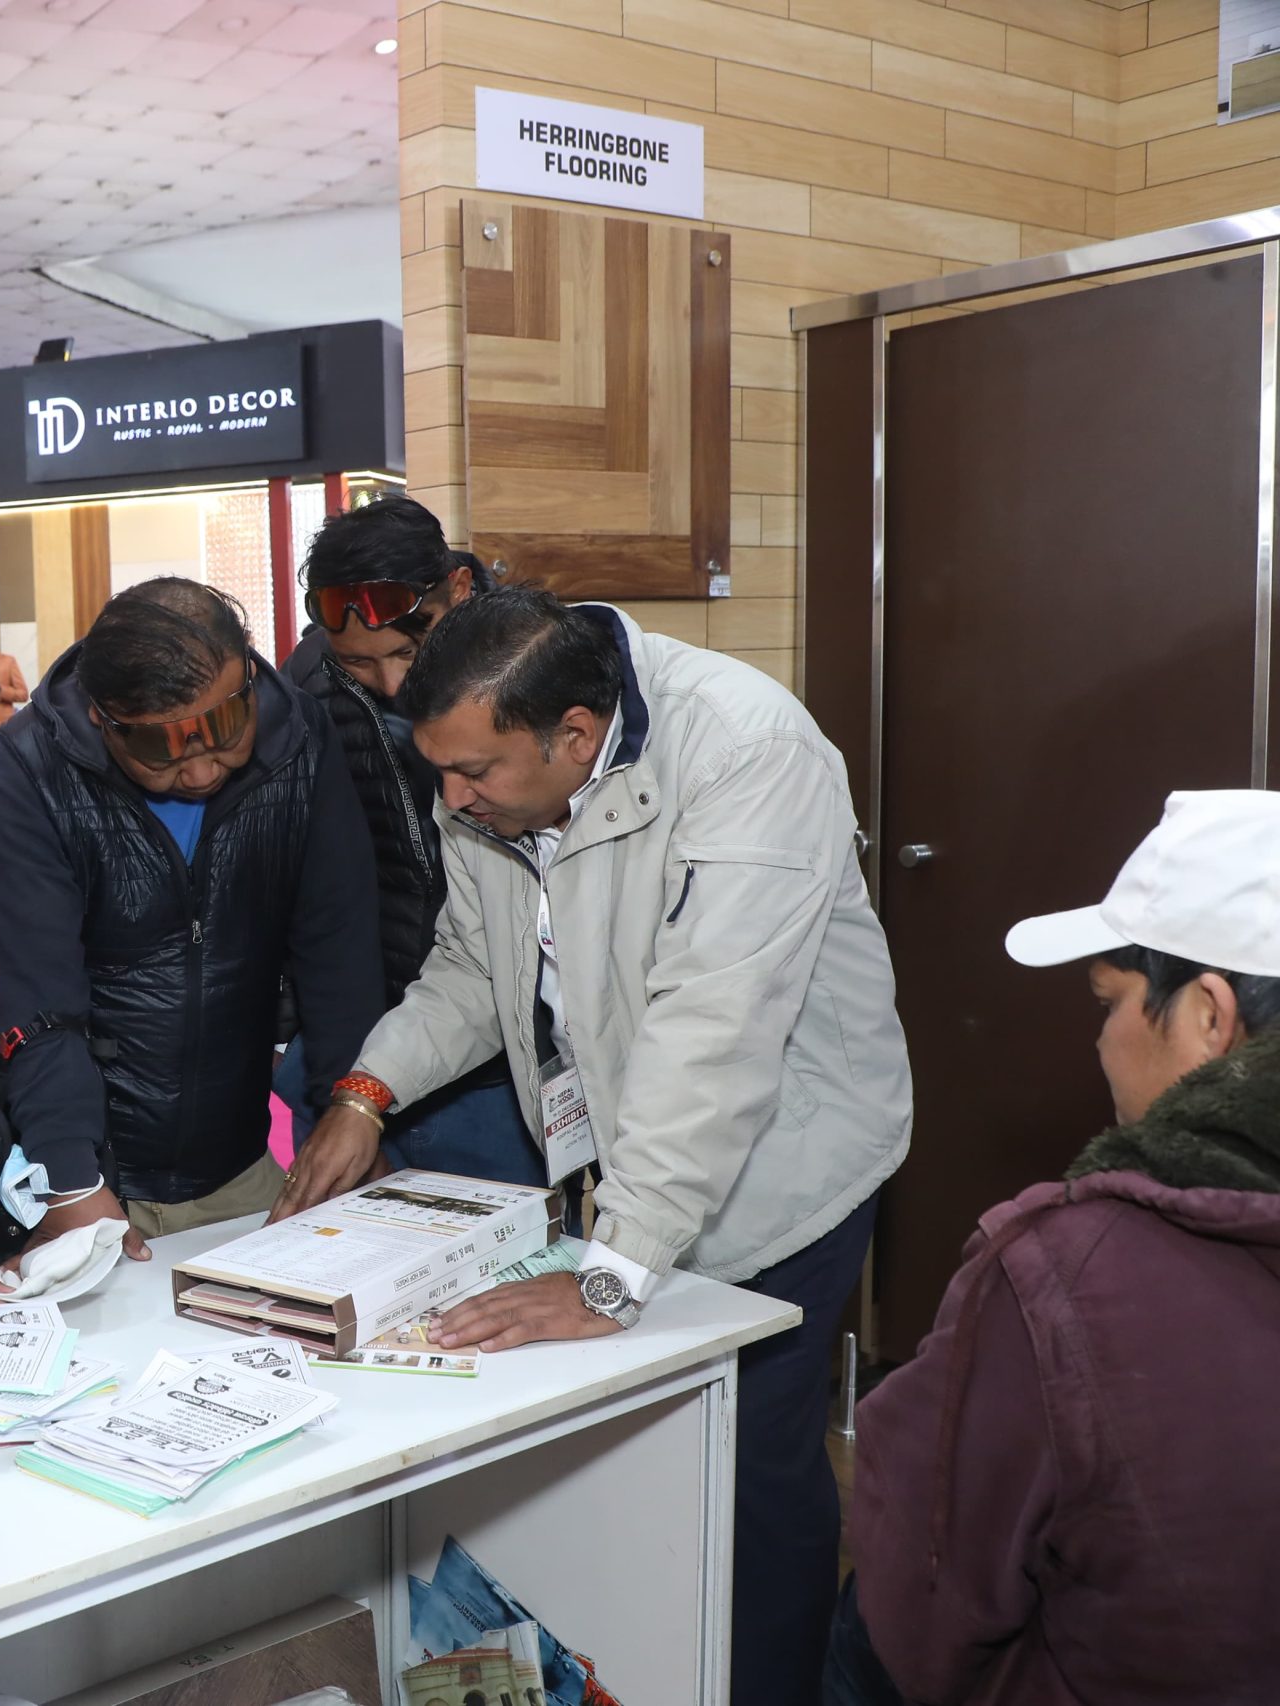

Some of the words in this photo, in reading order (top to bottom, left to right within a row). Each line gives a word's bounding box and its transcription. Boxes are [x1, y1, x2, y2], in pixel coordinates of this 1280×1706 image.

[519, 119, 669, 163] HERRINGBONE
[544, 151, 648, 187] FLOORING
[96, 397, 198, 426] INTERIO
[208, 387, 297, 415] DECOR
[113, 427, 152, 441] RUSTIC
[167, 422, 203, 436] ROYAL
[219, 416, 268, 431] MODERN
[252, 1359, 291, 1369] OORING
